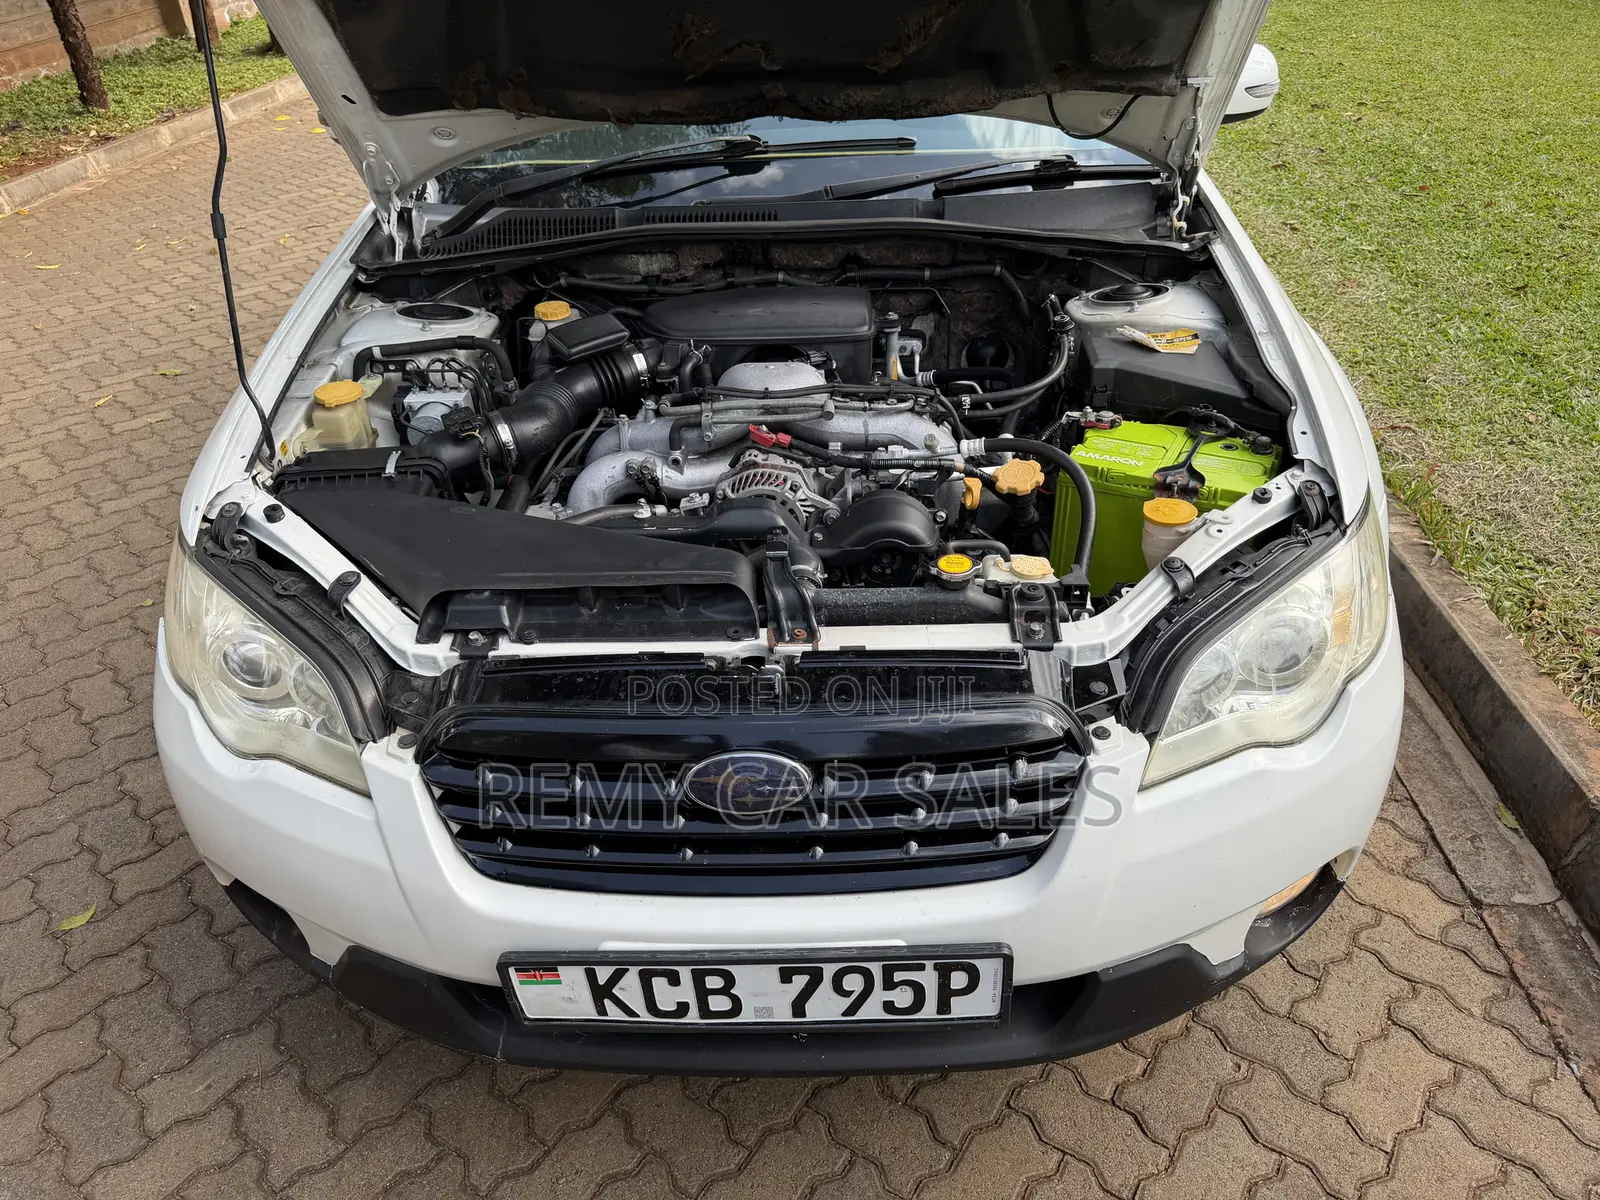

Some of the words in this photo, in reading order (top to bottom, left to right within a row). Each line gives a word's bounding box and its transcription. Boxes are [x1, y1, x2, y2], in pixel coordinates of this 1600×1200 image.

[1074, 450, 1144, 467] AMARON
[584, 966, 742, 1019] KCB
[778, 962, 979, 1018] 795P
